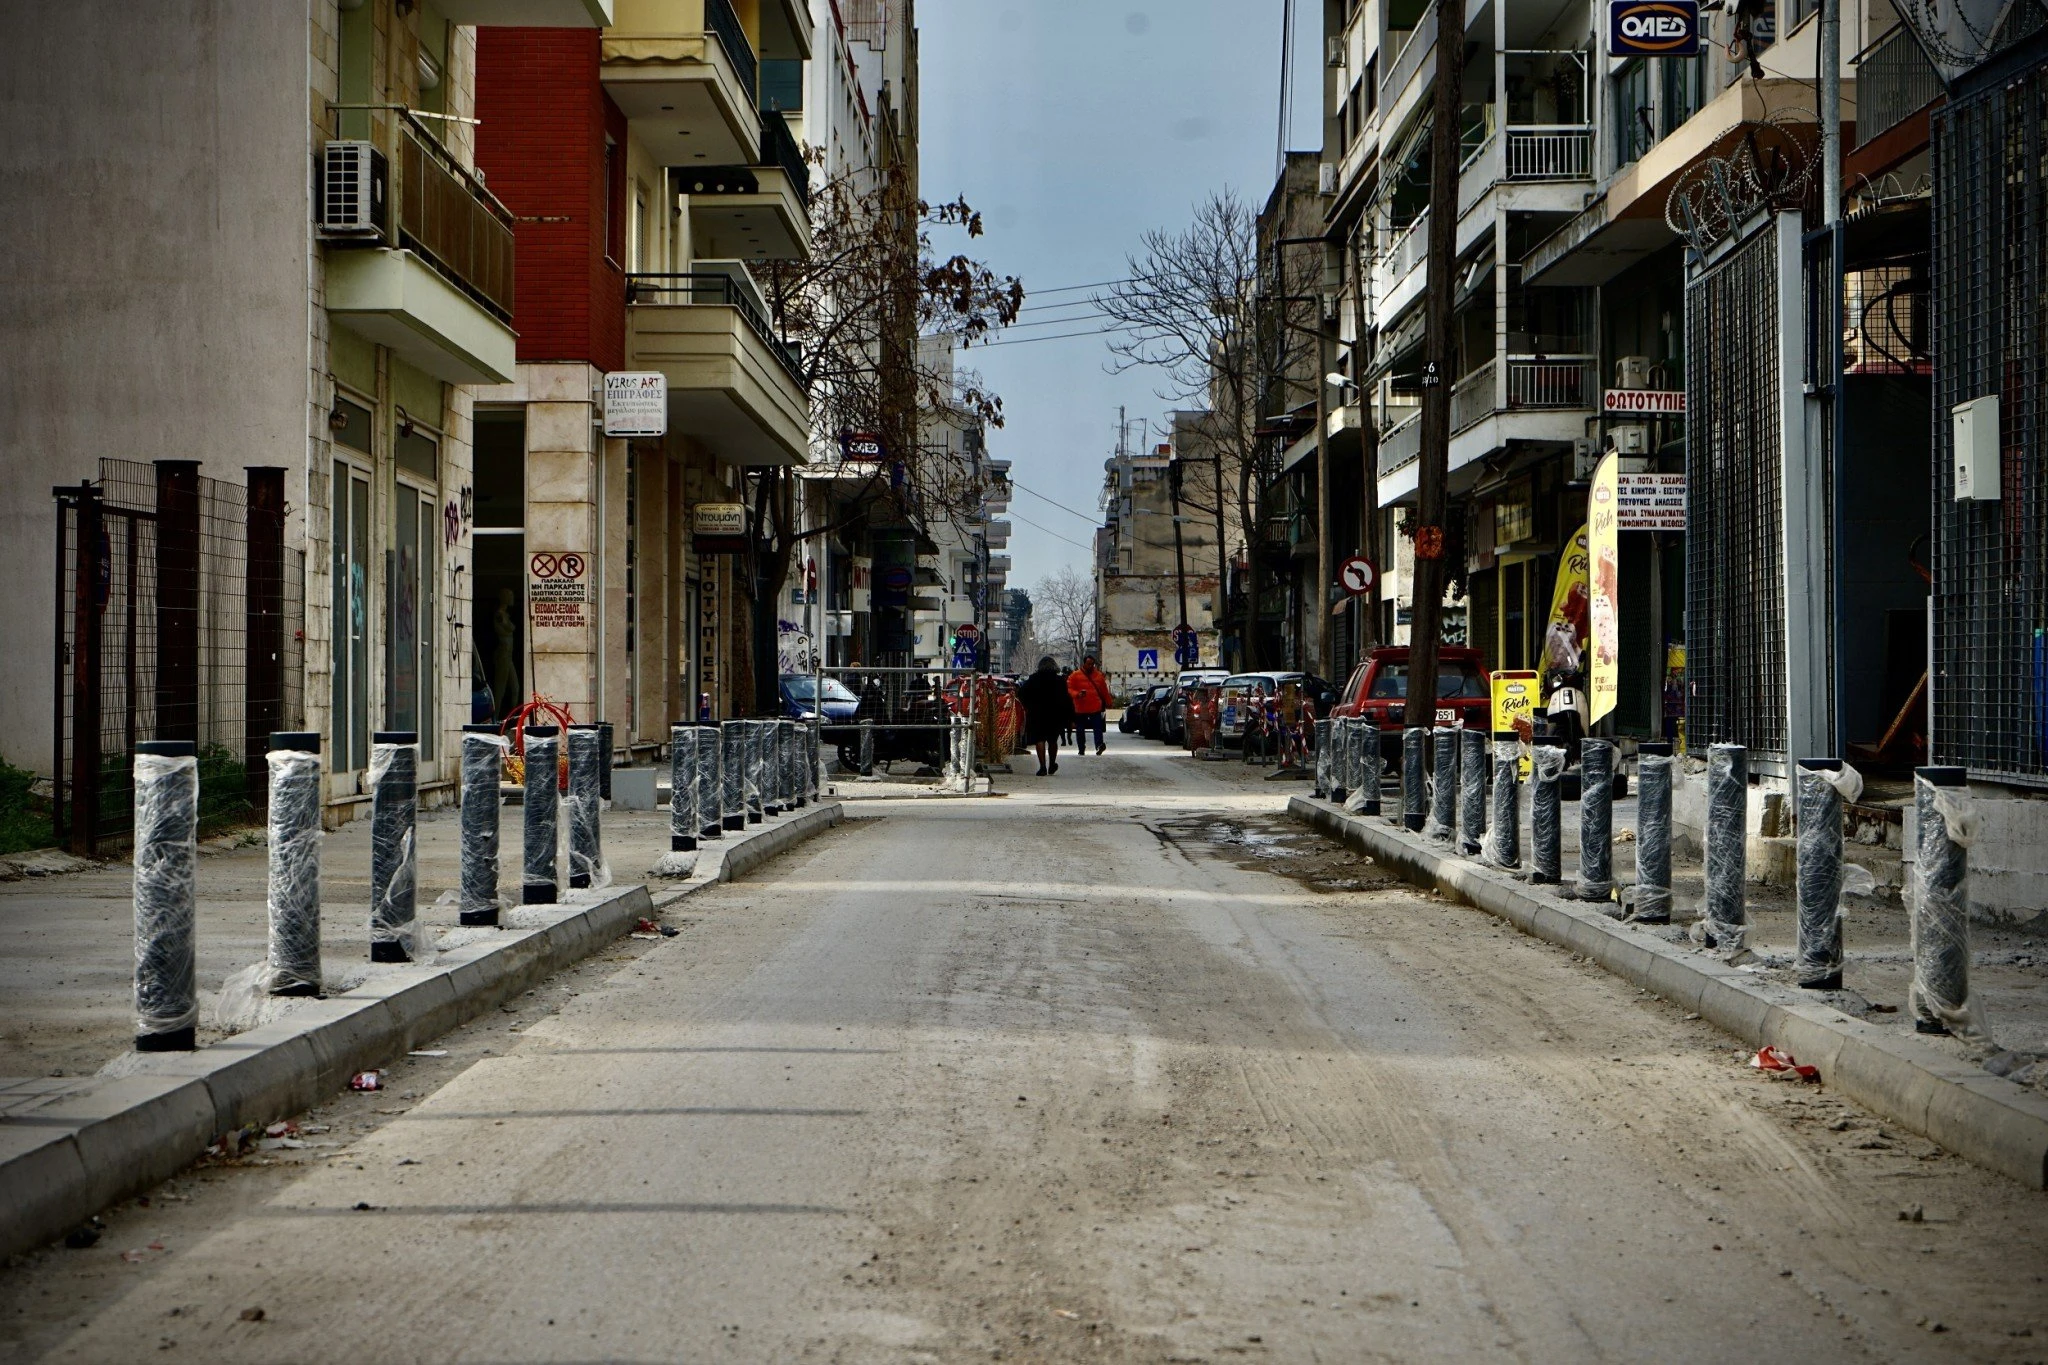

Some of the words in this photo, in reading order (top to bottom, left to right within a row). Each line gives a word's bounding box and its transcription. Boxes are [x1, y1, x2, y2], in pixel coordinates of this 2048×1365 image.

[607, 377, 637, 389] VIRUS
[641, 377, 661, 389] ART
[607, 390, 663, 400] ΕΠΙΓΡΑΦΕΣ
[1637, 477, 1653, 485] ΠΟΤΑ
[1631, 487, 1657, 495] ΚΙΝΗΤΩΝ
[1654, 498, 1683, 506] ΔΗΛΩΣΕΙΣ
[696, 511, 741, 525] Ντουμάνη
[534, 603, 580, 614] ΕΙΣΟΔΟΣ-ΕΞΟΔΟΣ
[1502, 696, 1531, 714] Rich
